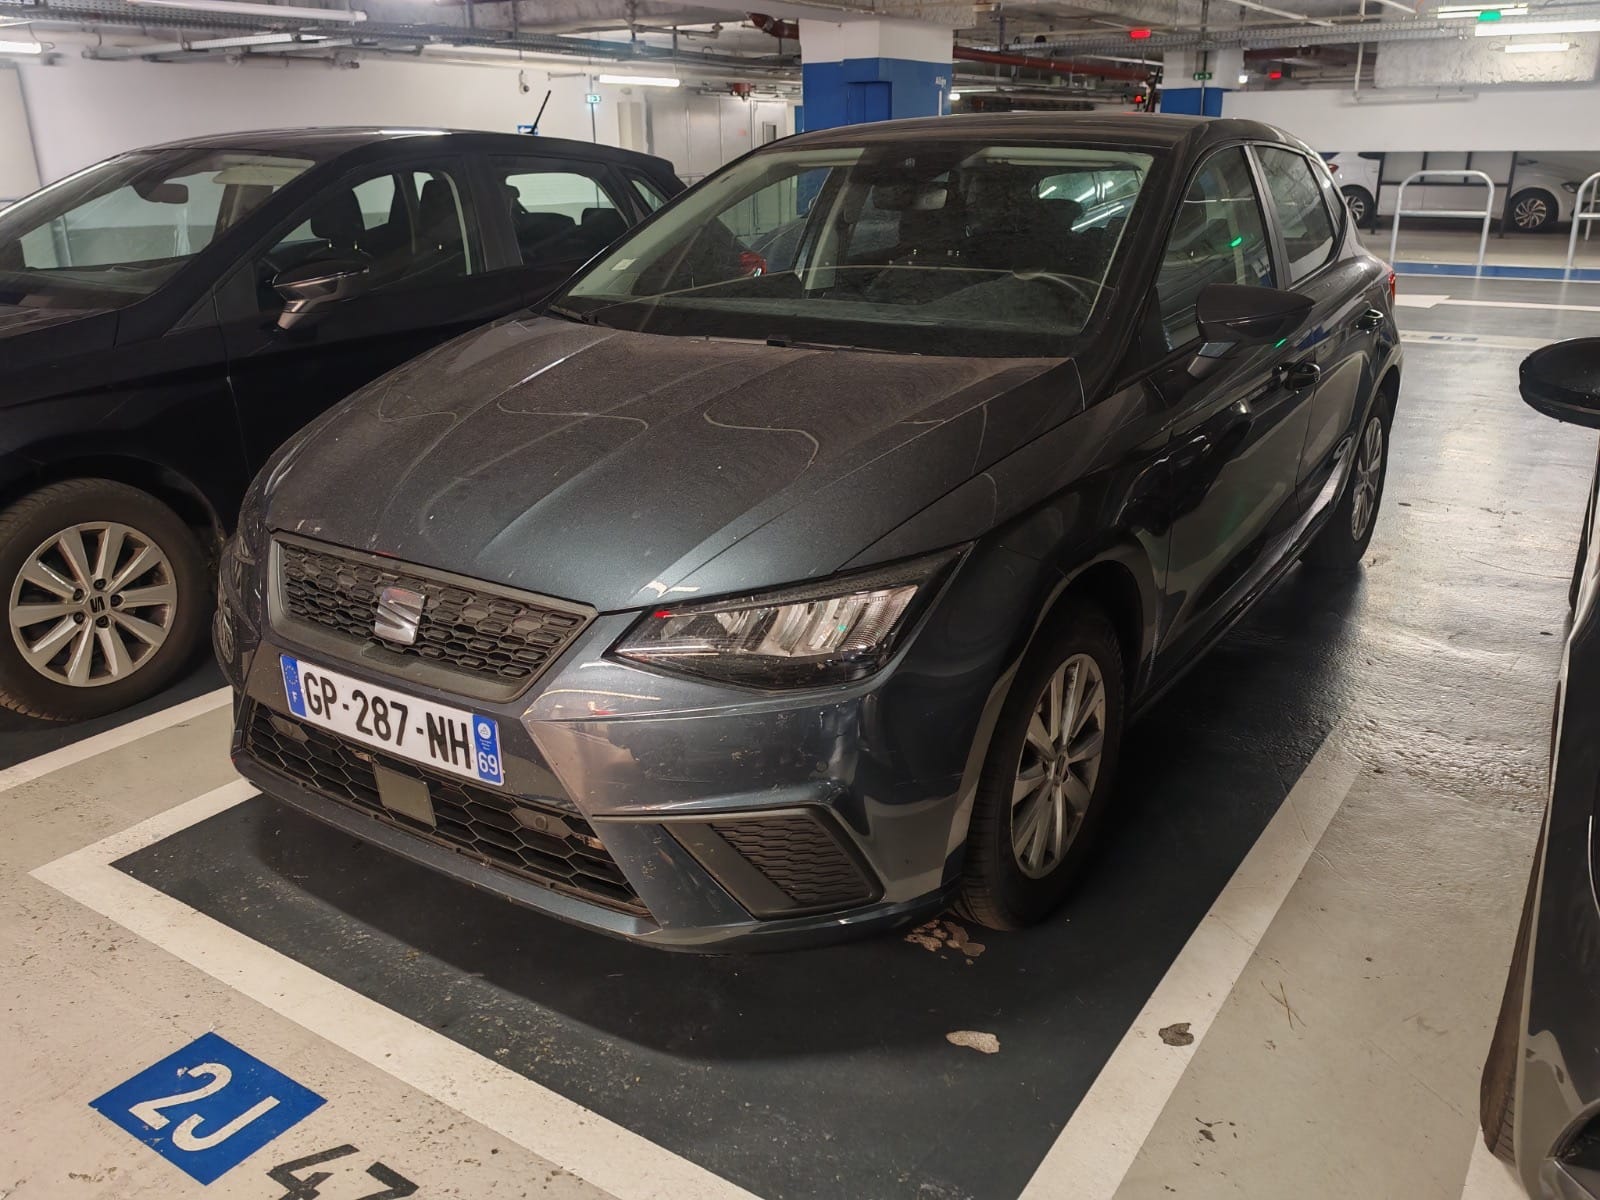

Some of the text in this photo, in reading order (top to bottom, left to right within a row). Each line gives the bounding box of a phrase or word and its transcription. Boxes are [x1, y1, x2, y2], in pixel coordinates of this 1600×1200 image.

[291, 691, 298, 703] F
[303, 671, 472, 770] GP-287-NH
[478, 751, 499, 776] 69
[128, 1062, 281, 1152] 2J
